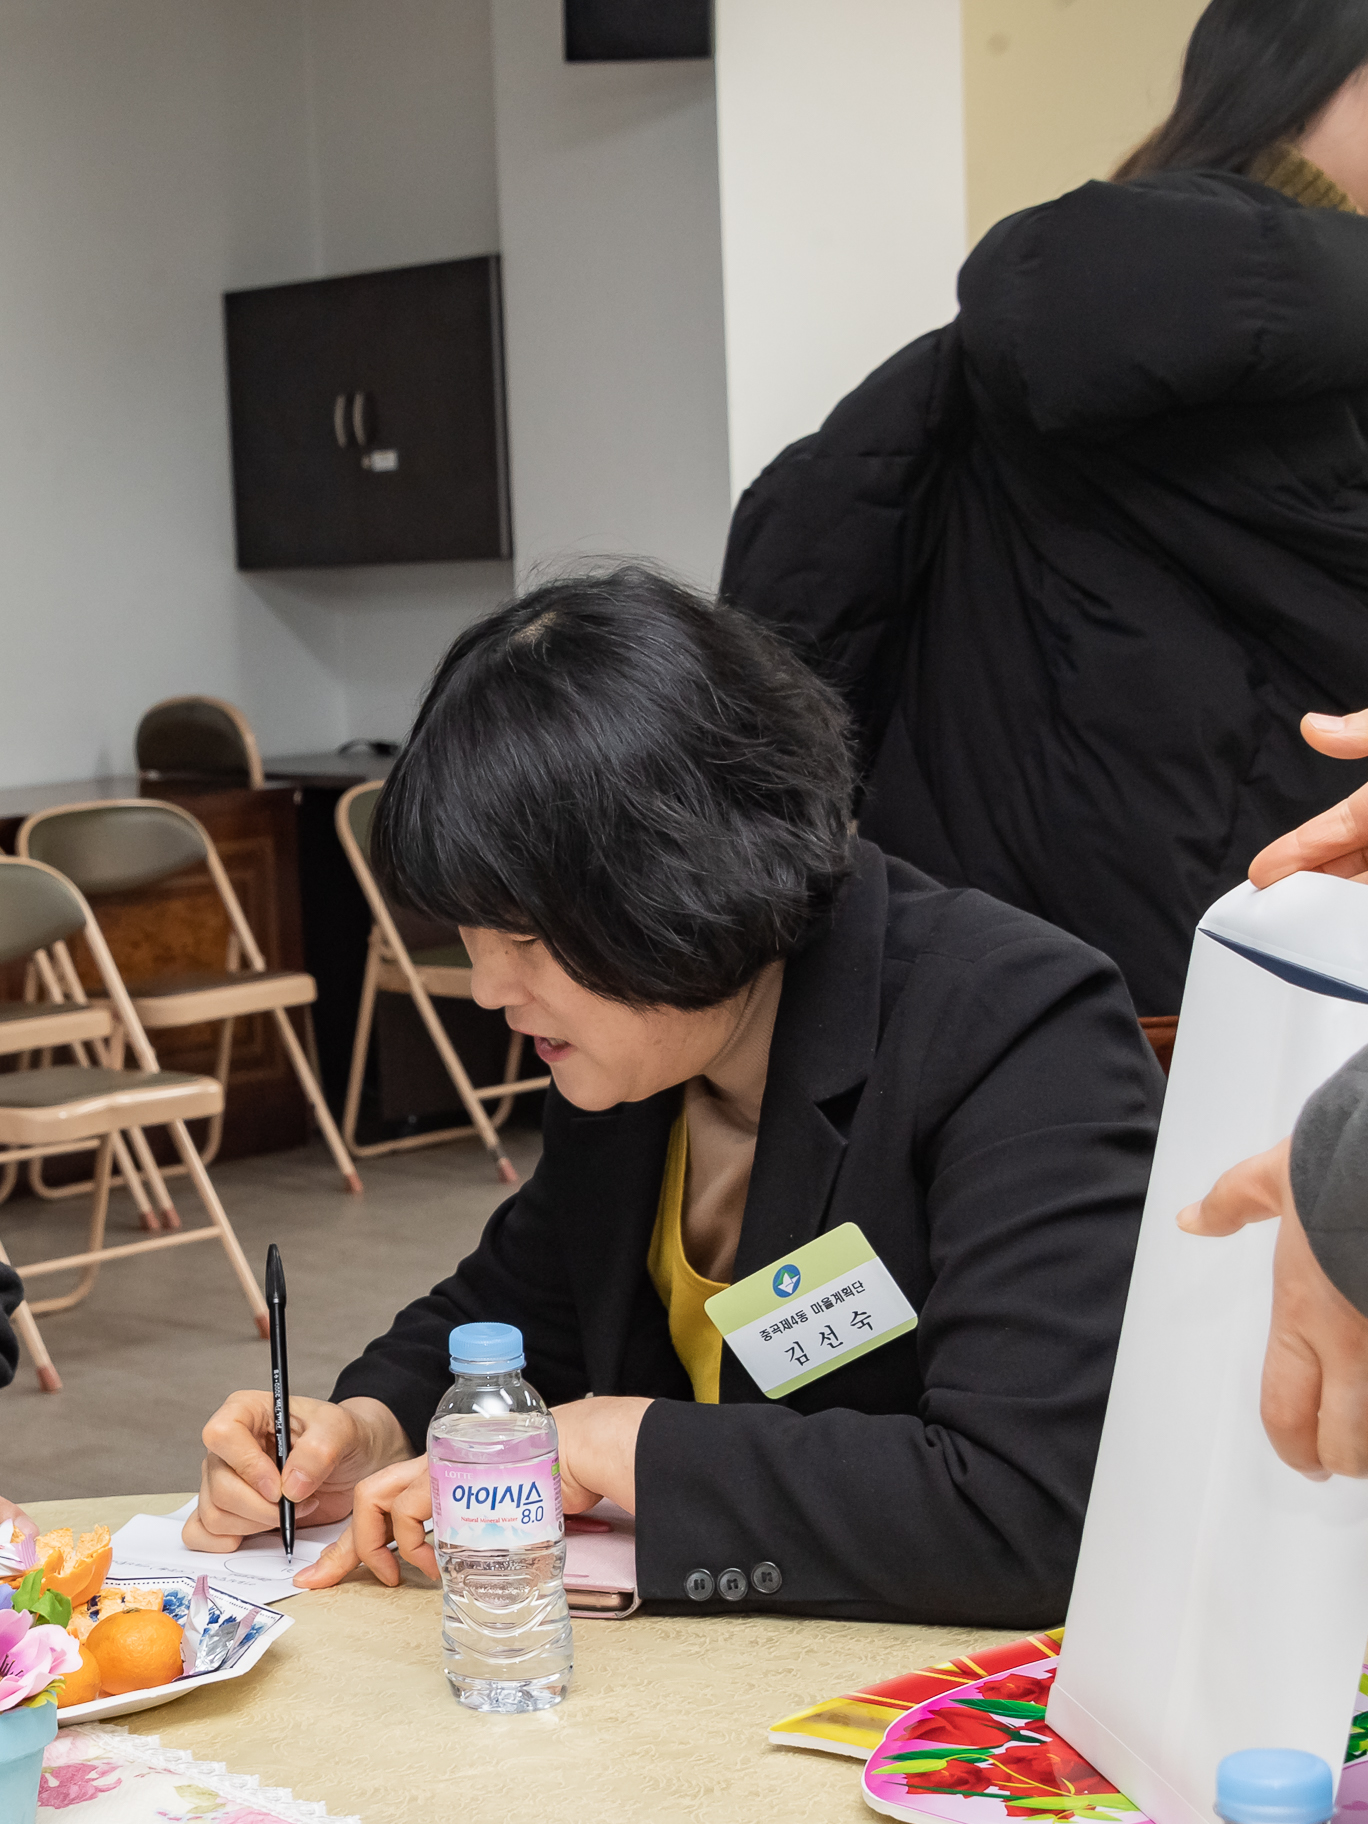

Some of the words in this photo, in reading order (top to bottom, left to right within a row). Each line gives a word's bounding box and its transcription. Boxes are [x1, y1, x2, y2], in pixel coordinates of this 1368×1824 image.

[759, 1310, 809, 1342] 중곡제4동
[810, 1280, 866, 1315] 마을계획단
[444, 1470, 473, 1480] LOTTE
[452, 1481, 543, 1510] 아이시스
[521, 1505, 544, 1525] 8.0
